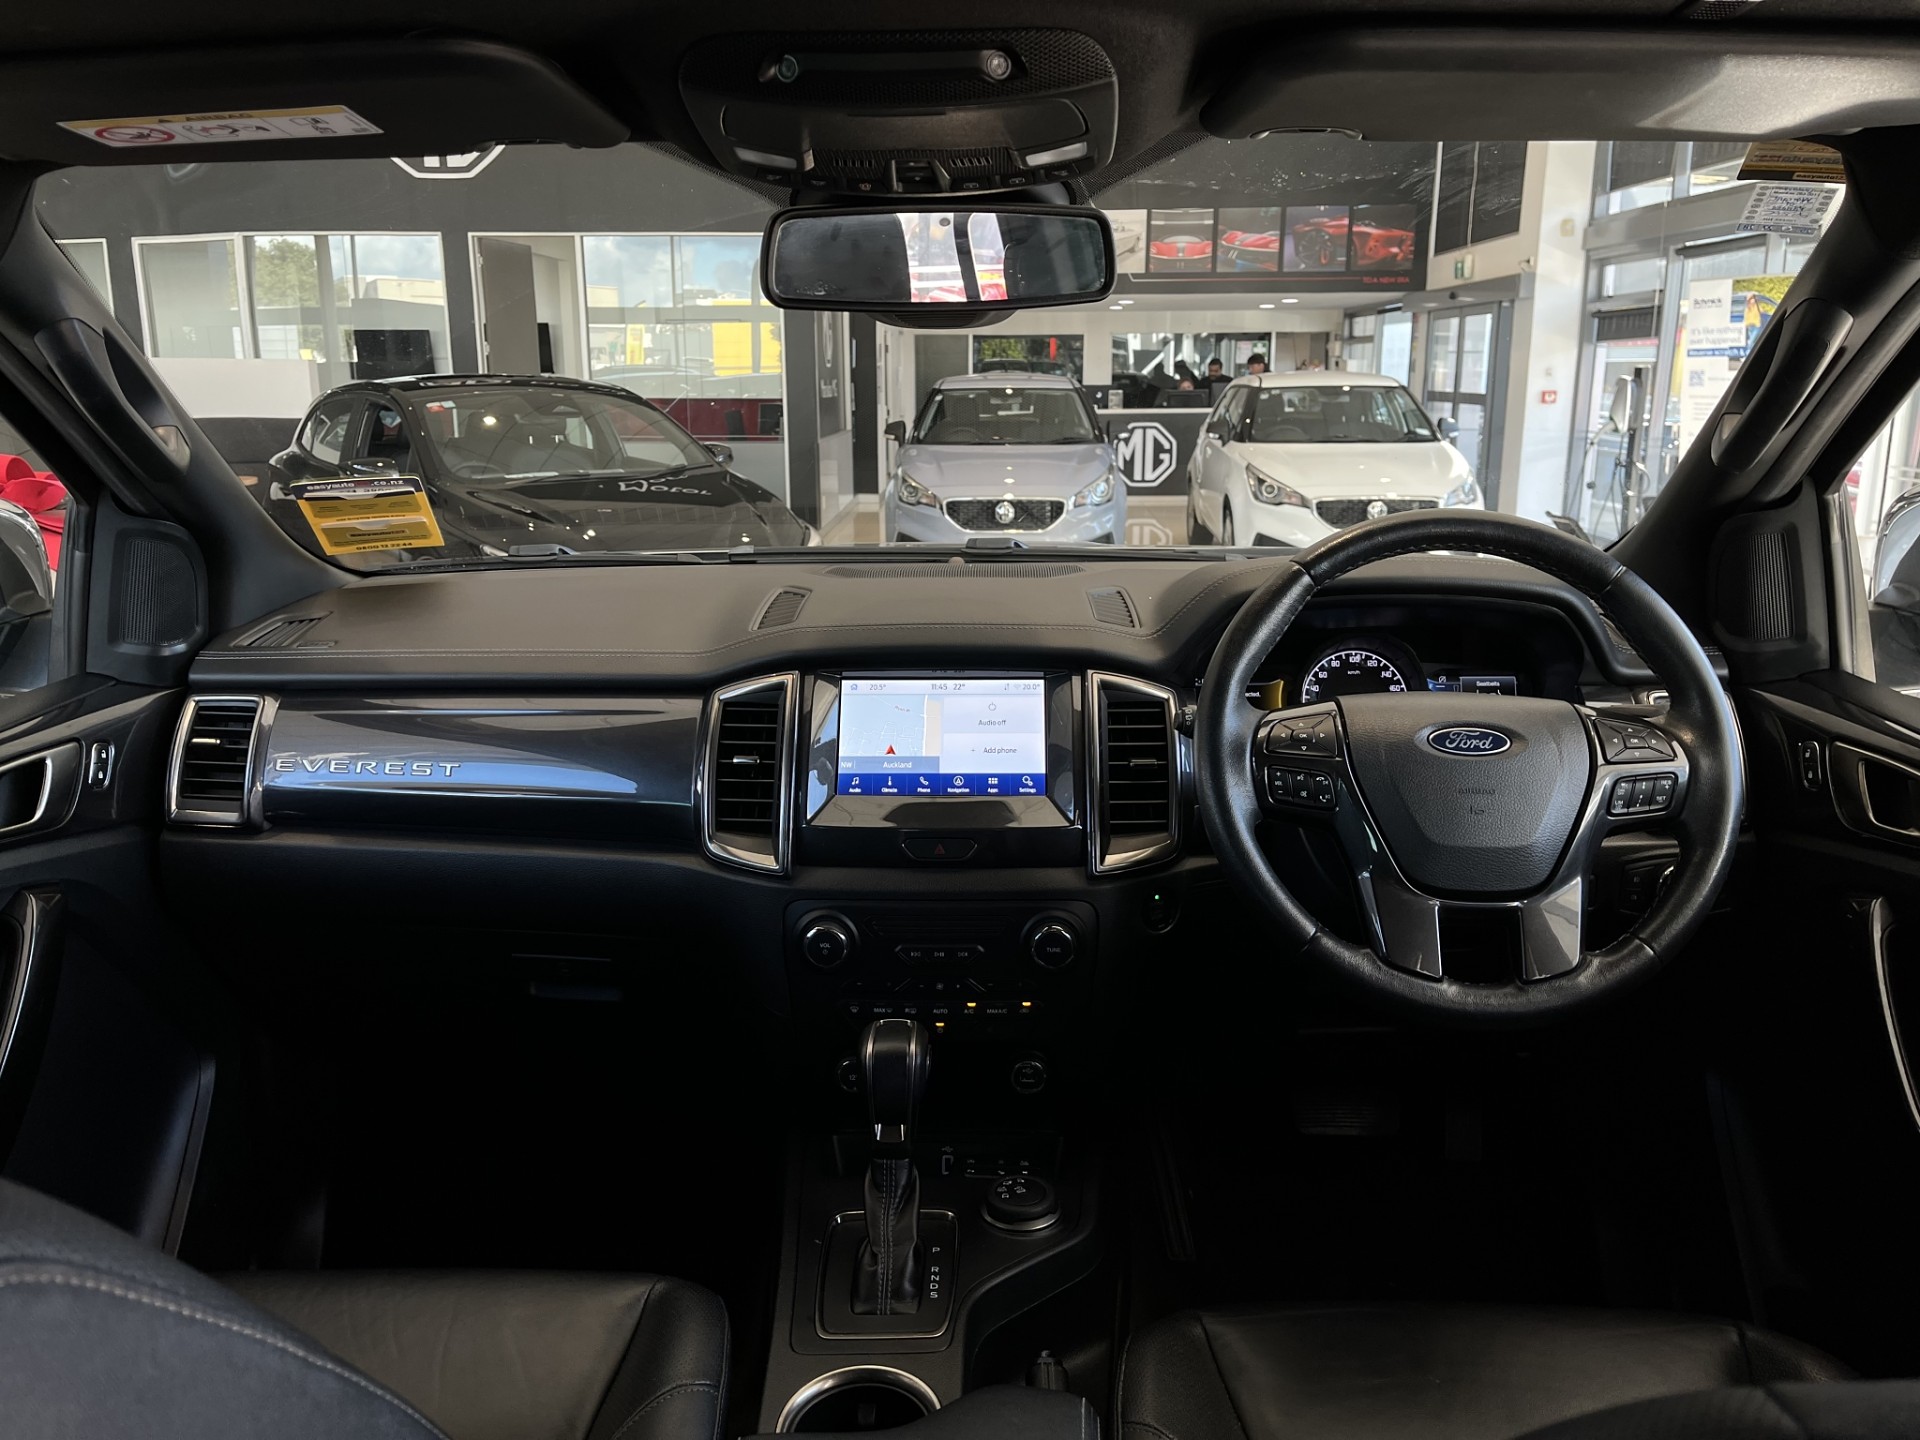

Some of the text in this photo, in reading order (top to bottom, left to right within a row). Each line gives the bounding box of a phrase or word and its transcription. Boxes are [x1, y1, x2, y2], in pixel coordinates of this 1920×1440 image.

[1117, 427, 1171, 482] MG
[306, 479, 405, 491] easyauto.co.nz
[1331, 660, 1340, 668] 80
[1318, 671, 1328, 679] 60
[953, 683, 966, 691] 22°
[978, 719, 1007, 727] Audio off
[1445, 730, 1493, 749] Ford
[983, 746, 1018, 755] Add phone
[275, 758, 462, 777] EVEREST
[883, 761, 912, 769] Auckland
